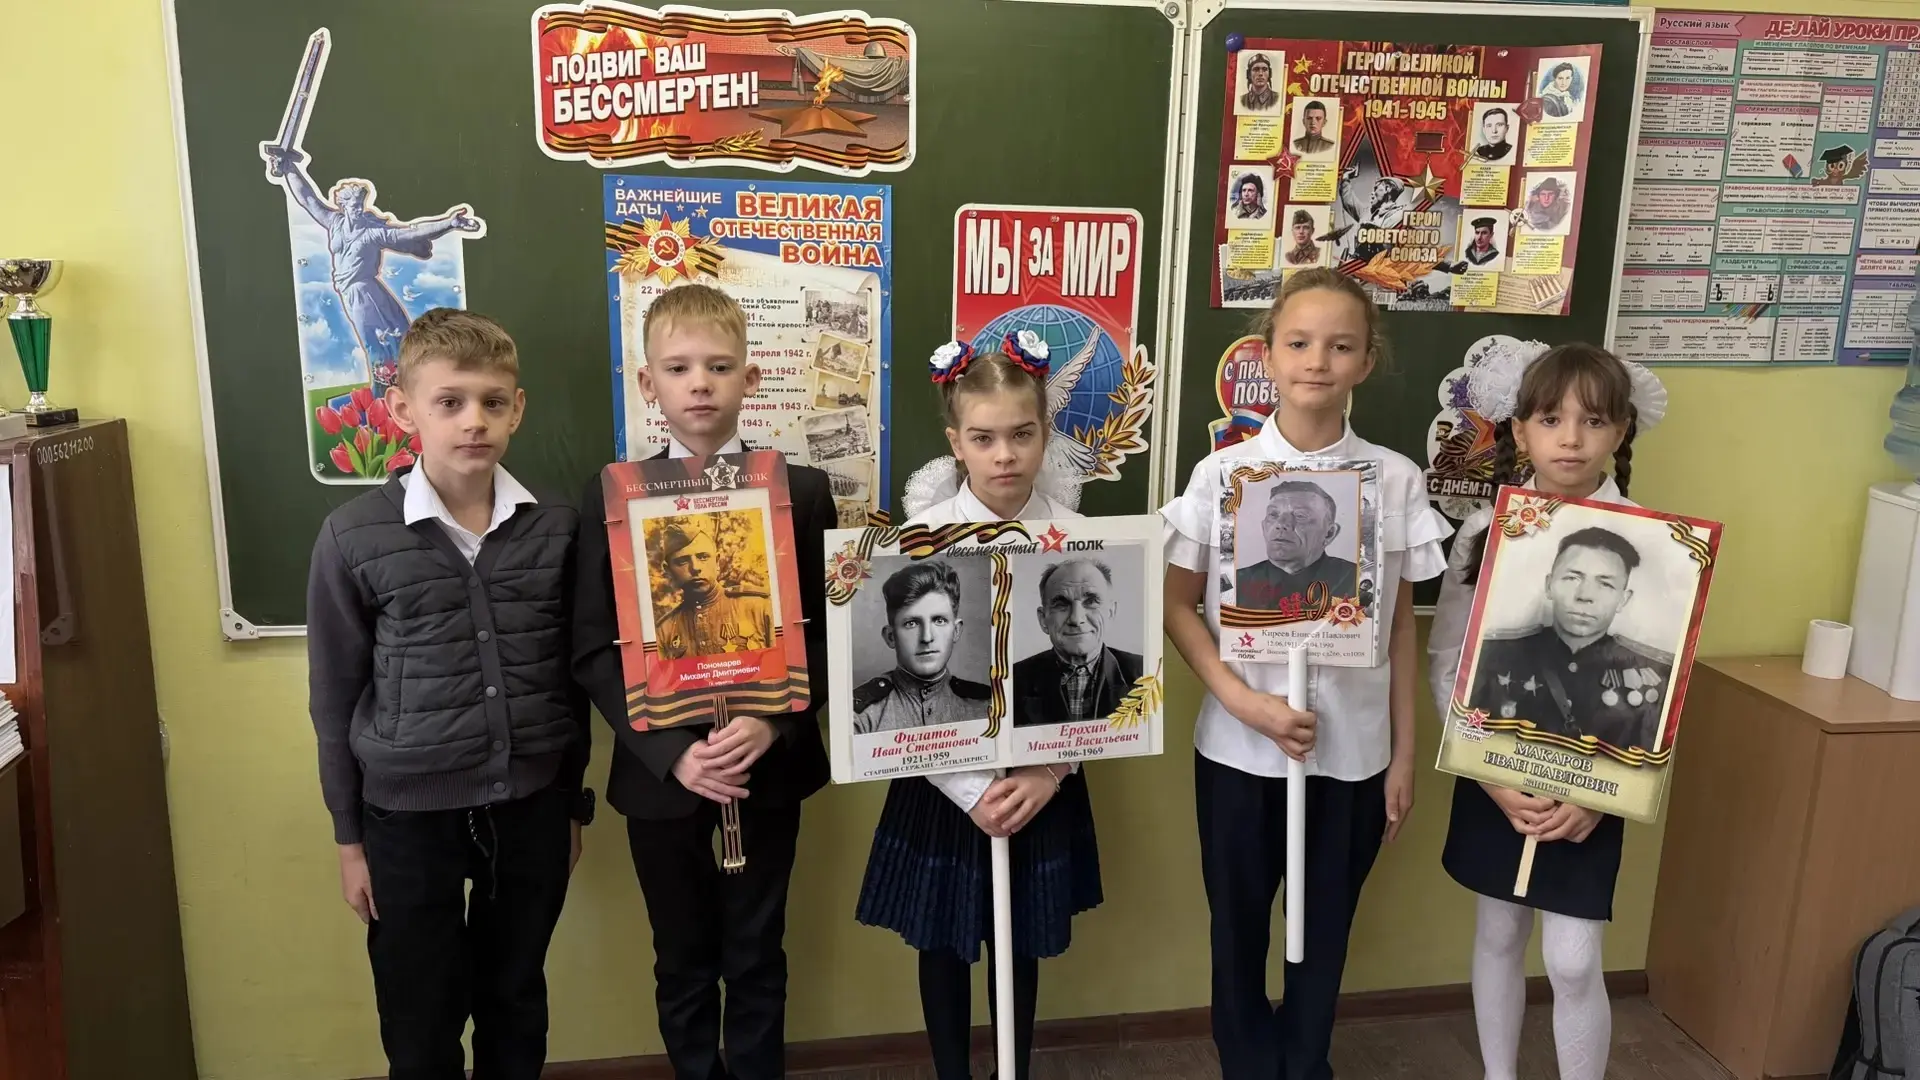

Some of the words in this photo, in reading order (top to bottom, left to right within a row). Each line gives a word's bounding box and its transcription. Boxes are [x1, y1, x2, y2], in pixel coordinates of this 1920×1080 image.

[1660, 18, 1702, 29] Русский
[1764, 18, 1830, 40] ДЕЛАЙ
[1834, 22, 1892, 41] УРОКИ
[552, 48, 648, 85] ПОДВИГ
[654, 43, 706, 75] ВАШ
[1348, 52, 1398, 71] ГЕРОИ
[1400, 52, 1474, 74] ВЕЛИКОЙ
[1309, 73, 1444, 98] ОТЕЧЕСТВЕННОЙ
[1446, 76, 1508, 99] ВОЙНЫ
[554, 71, 760, 123] БЕССМЕРТЕН!
[1365, 100, 1447, 120] 1941-1945
[615, 188, 722, 204] ВАЖНЕЙШИЕ
[736, 191, 883, 221] ВЕЛИКАЯ
[616, 202, 661, 216] ДАТЫ
[710, 218, 882, 242] ОТЕЧЕСТВЕННАЯ
[1402, 212, 1442, 228] ГЕРОИ
[1357, 229, 1440, 246] СОВЕТСКОГО
[780, 240, 883, 267] ВОЙНА
[964, 218, 1022, 295] МЫ
[1028, 227, 1054, 276] ЗА
[1061, 221, 1130, 297] МИР
[1391, 247, 1438, 263] СОЮЗА
[750, 350, 781, 358] апреля
[1224, 362, 1233, 381] С
[1234, 381, 1280, 405] ПОБЕ
[626, 476, 710, 493] БЕССМЕРТНЫЙ
[737, 472, 768, 484] ПОЛК
[1430, 478, 1439, 492] С
[1441, 478, 1479, 496] ДНЁМ
[680, 672, 710, 682] Михаил
[712, 666, 760, 678] Дмитриевич
[697, 659, 741, 671] Пономарев
[894, 728, 958, 744] Филатов
[1059, 723, 1108, 738] Ерохин
[872, 745, 902, 759] Иван
[906, 735, 979, 753] Степанович
[1027, 738, 1071, 752] Михаил
[1075, 732, 1140, 748] Васильевич
[902, 752, 950, 765] 1921-1959
[1057, 747, 1104, 759] 1906-1969
[1514, 743, 1593, 772] МАКАРОВ
[864, 765, 899, 776] СТАРШИЙ
[901, 761, 933, 772] СЕРЖАНТ
[940, 755, 989, 768] АРТИЛЛЕРИСТ
[1484, 752, 1528, 772] ИВАН
[1529, 762, 1618, 796] ПАВЛОВИЧ
[1524, 778, 1570, 796] капитан
